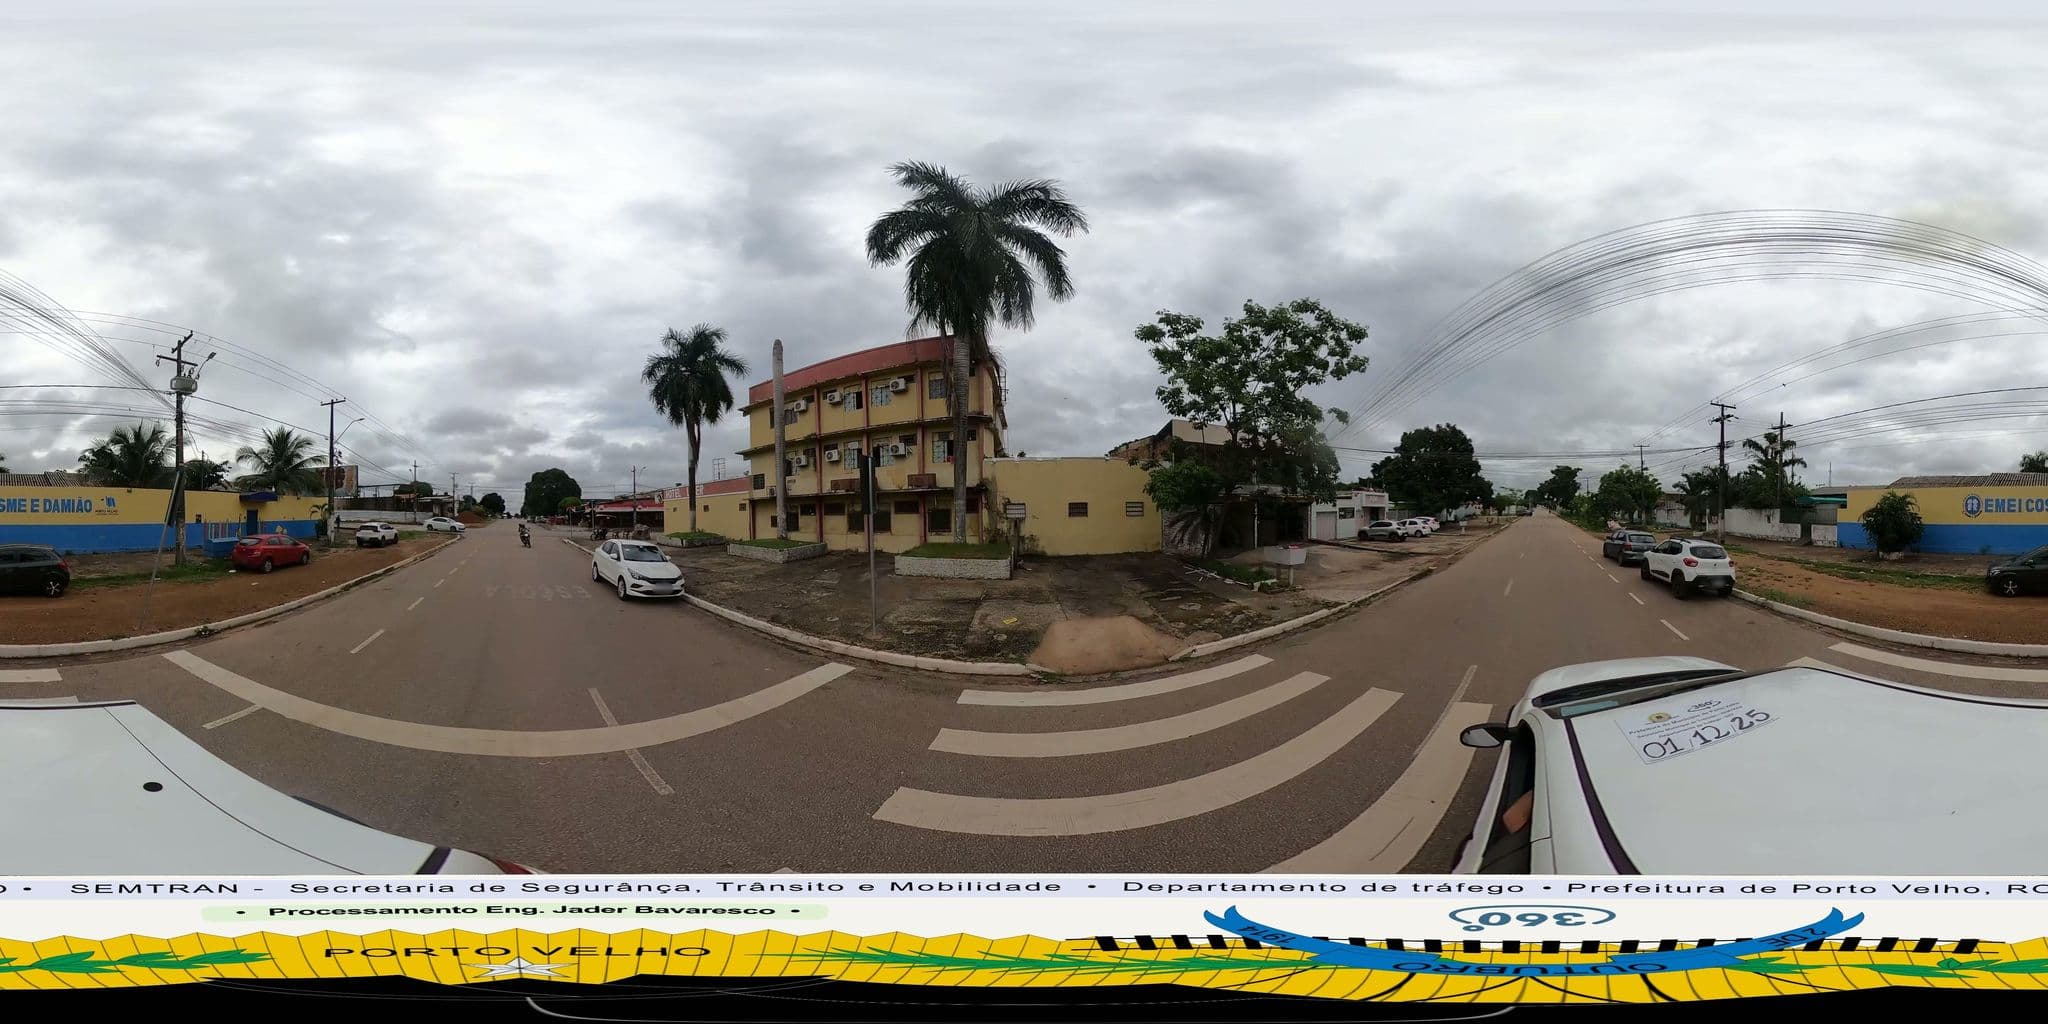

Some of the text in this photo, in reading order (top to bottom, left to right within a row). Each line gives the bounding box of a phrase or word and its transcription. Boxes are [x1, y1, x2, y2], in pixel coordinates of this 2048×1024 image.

[663, 486, 681, 499] HOTEL
[30, 497, 40, 513] E
[43, 496, 93, 513] DAMIÃO
[1984, 498, 2022, 513] EMEI
